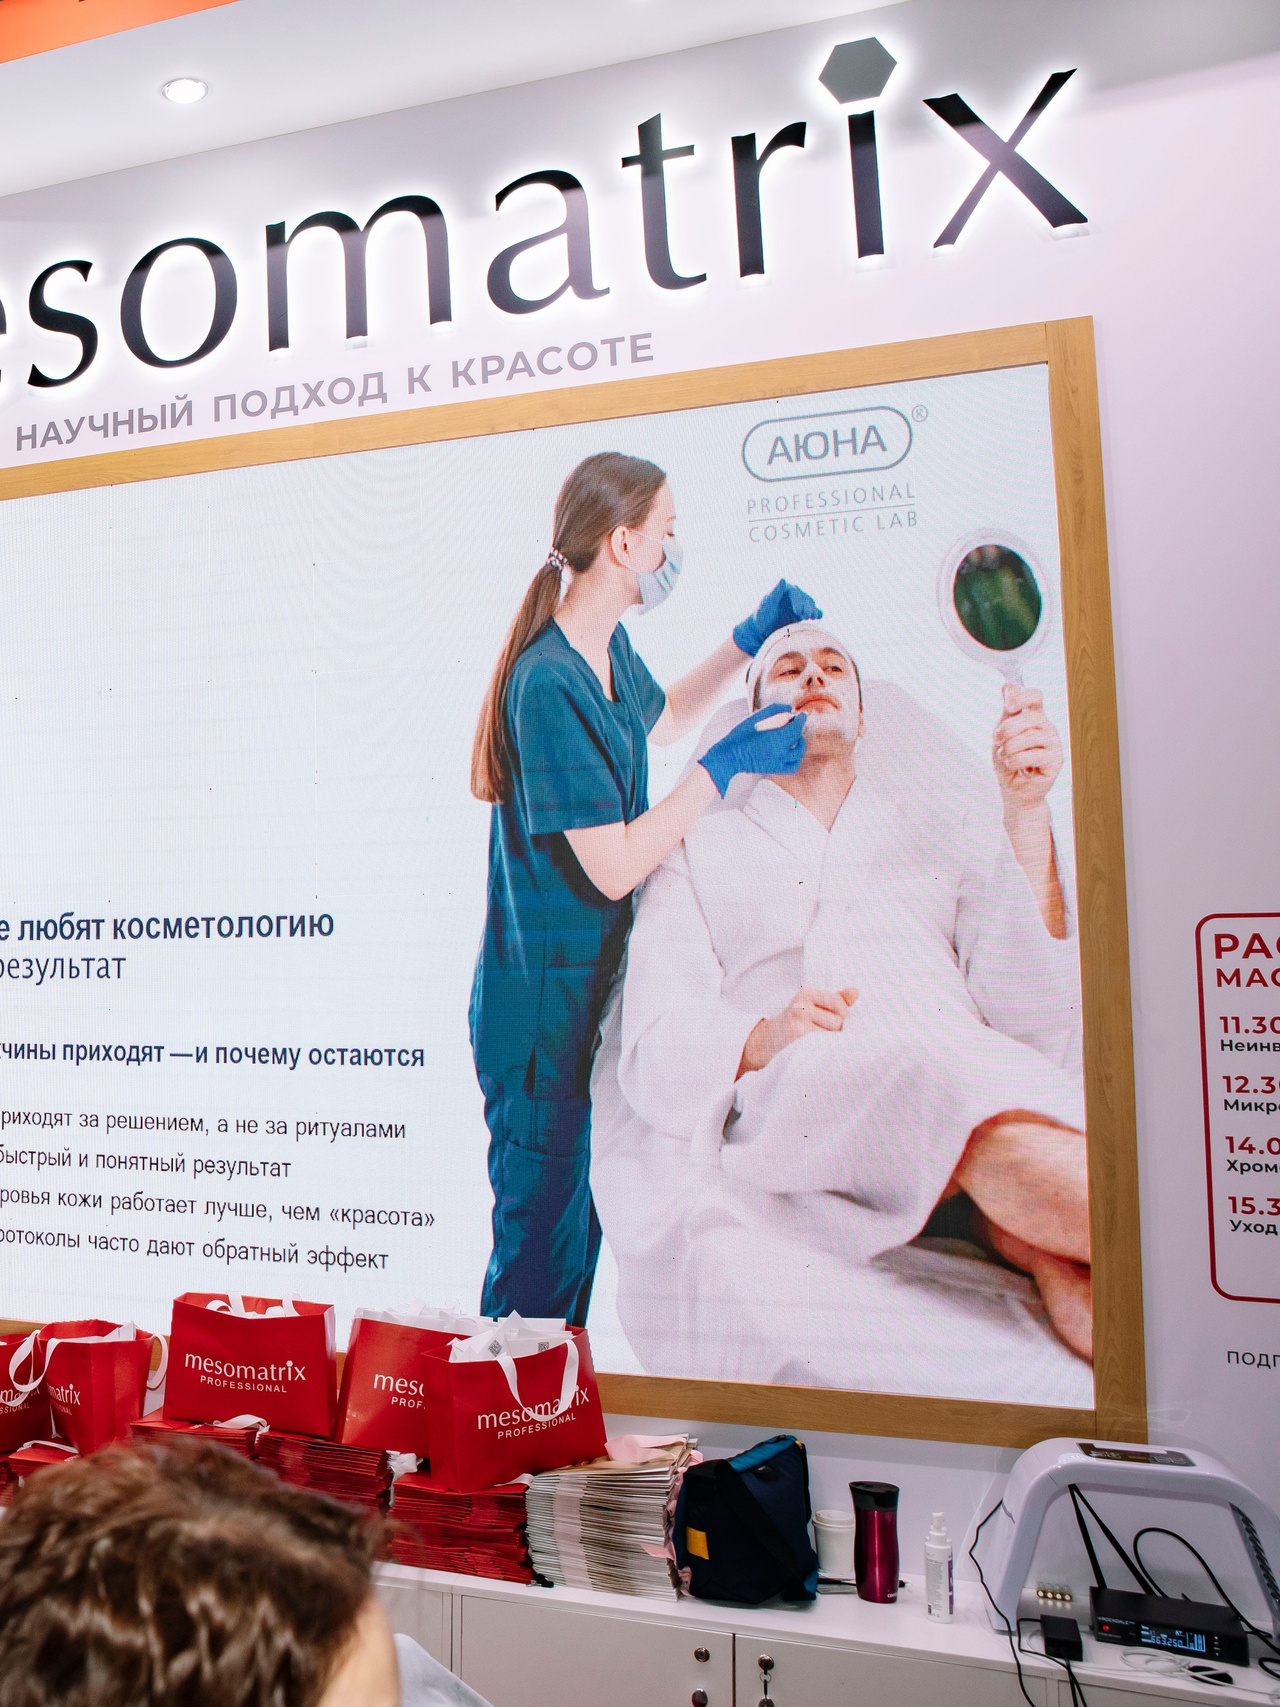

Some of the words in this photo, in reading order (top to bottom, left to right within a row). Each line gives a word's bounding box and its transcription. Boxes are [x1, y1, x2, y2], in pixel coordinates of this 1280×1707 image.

[16, 395, 194, 452] НАУЧНЫЙ
[214, 371, 387, 423] ПОДХОД
[408, 364, 432, 395] К
[452, 332, 654, 389] КРАСОТЕ
[767, 425, 887, 465] АЮНА
[747, 483, 915, 514] PROFESSIONAL
[749, 516, 864, 543] COSMETIC
[877, 511, 918, 530] LAB
[18, 912, 105, 941] любят
[113, 914, 334, 940] косметологию
[1214, 933, 1280, 960] РА
[62, 1043, 165, 1067] приходят
[215, 1047, 301, 1070] почему
[308, 1048, 425, 1067] остаются
[1222, 1075, 1280, 1094] 12.3
[1224, 1098, 1280, 1115] Микр
[79, 1113, 99, 1128] за
[106, 1114, 209, 1135] решением,
[217, 1119, 228, 1132] а
[236, 1119, 258, 1134] не
[265, 1120, 287, 1135] за
[296, 1120, 406, 1143] ритуалами
[79, 1153, 88, 1167] и
[96, 1152, 185, 1172] понятный
[193, 1157, 291, 1181] результат
[58, 1192, 102, 1208] кожи
[111, 1191, 196, 1215] работает
[204, 1201, 272, 1222] лучше,
[282, 1205, 320, 1221] чем
[330, 1207, 435, 1230] «красота»
[1230, 1219, 1278, 1236] Уход
[88, 1235, 139, 1252] часто
[147, 1240, 195, 1257] дают
[202, 1238, 298, 1265] обратный
[307, 1245, 389, 1273] эффект
[185, 1351, 306, 1382] mesomatrix
[200, 1374, 287, 1393] PROFESSIONAL
[498, 1413, 576, 1439] PROFESSIONAL
